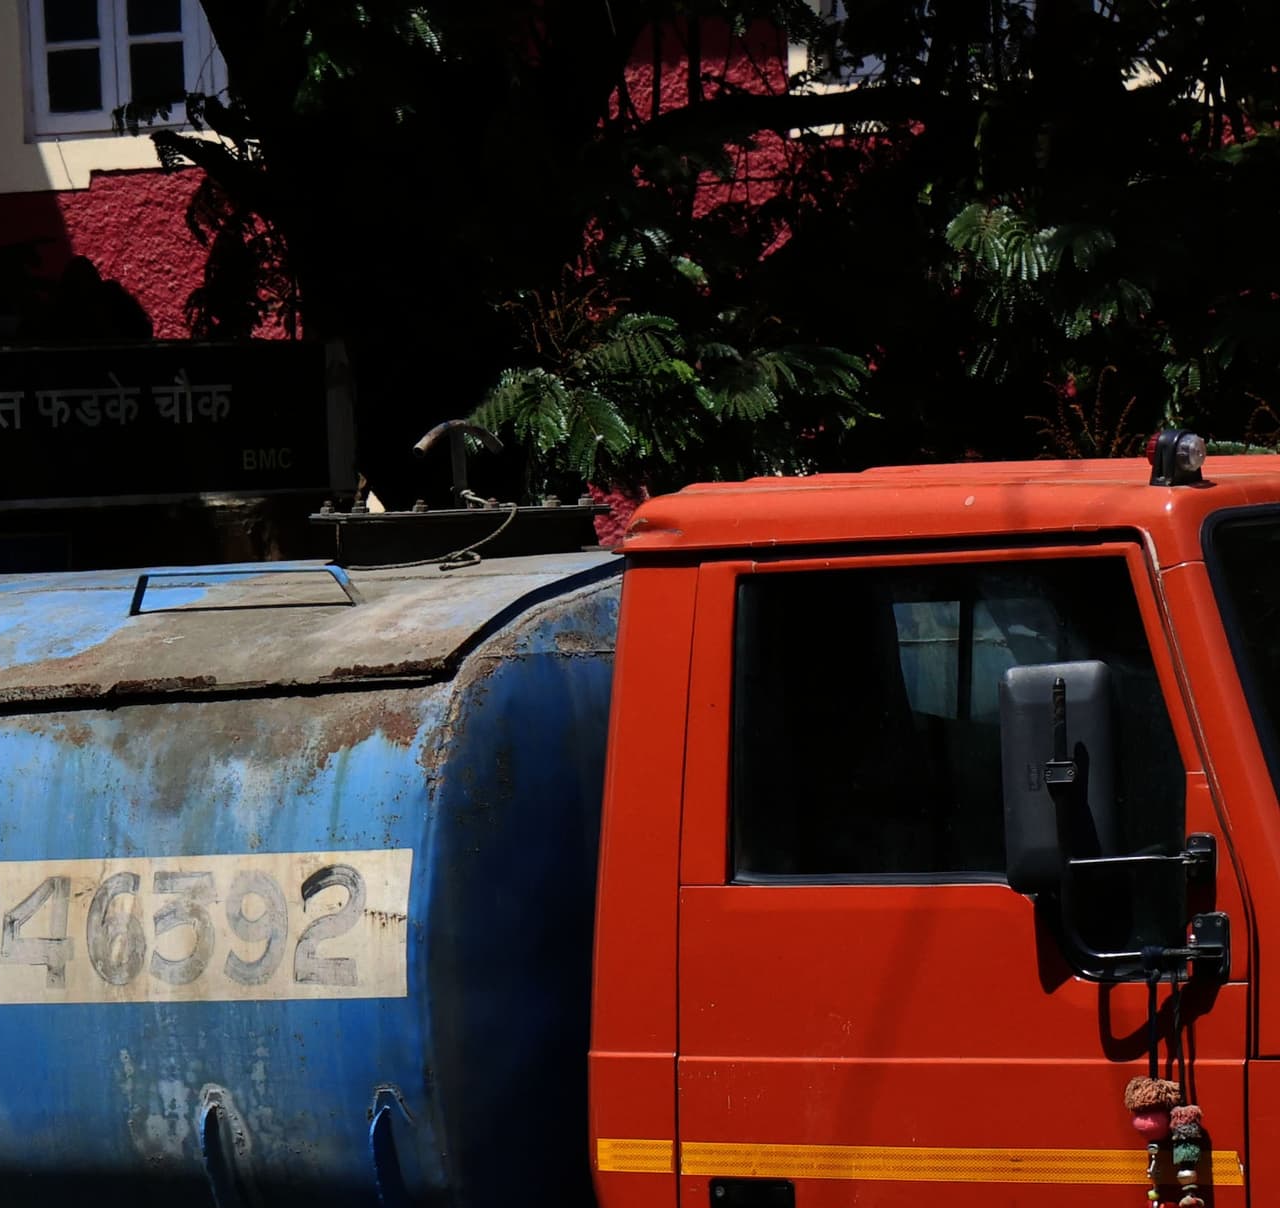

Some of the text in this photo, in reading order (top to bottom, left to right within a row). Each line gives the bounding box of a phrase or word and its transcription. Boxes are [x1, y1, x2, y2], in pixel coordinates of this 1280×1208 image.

[34, 370, 142, 427] फडके
[151, 368, 233, 425] चौक
[242, 448, 294, 472] BMC
